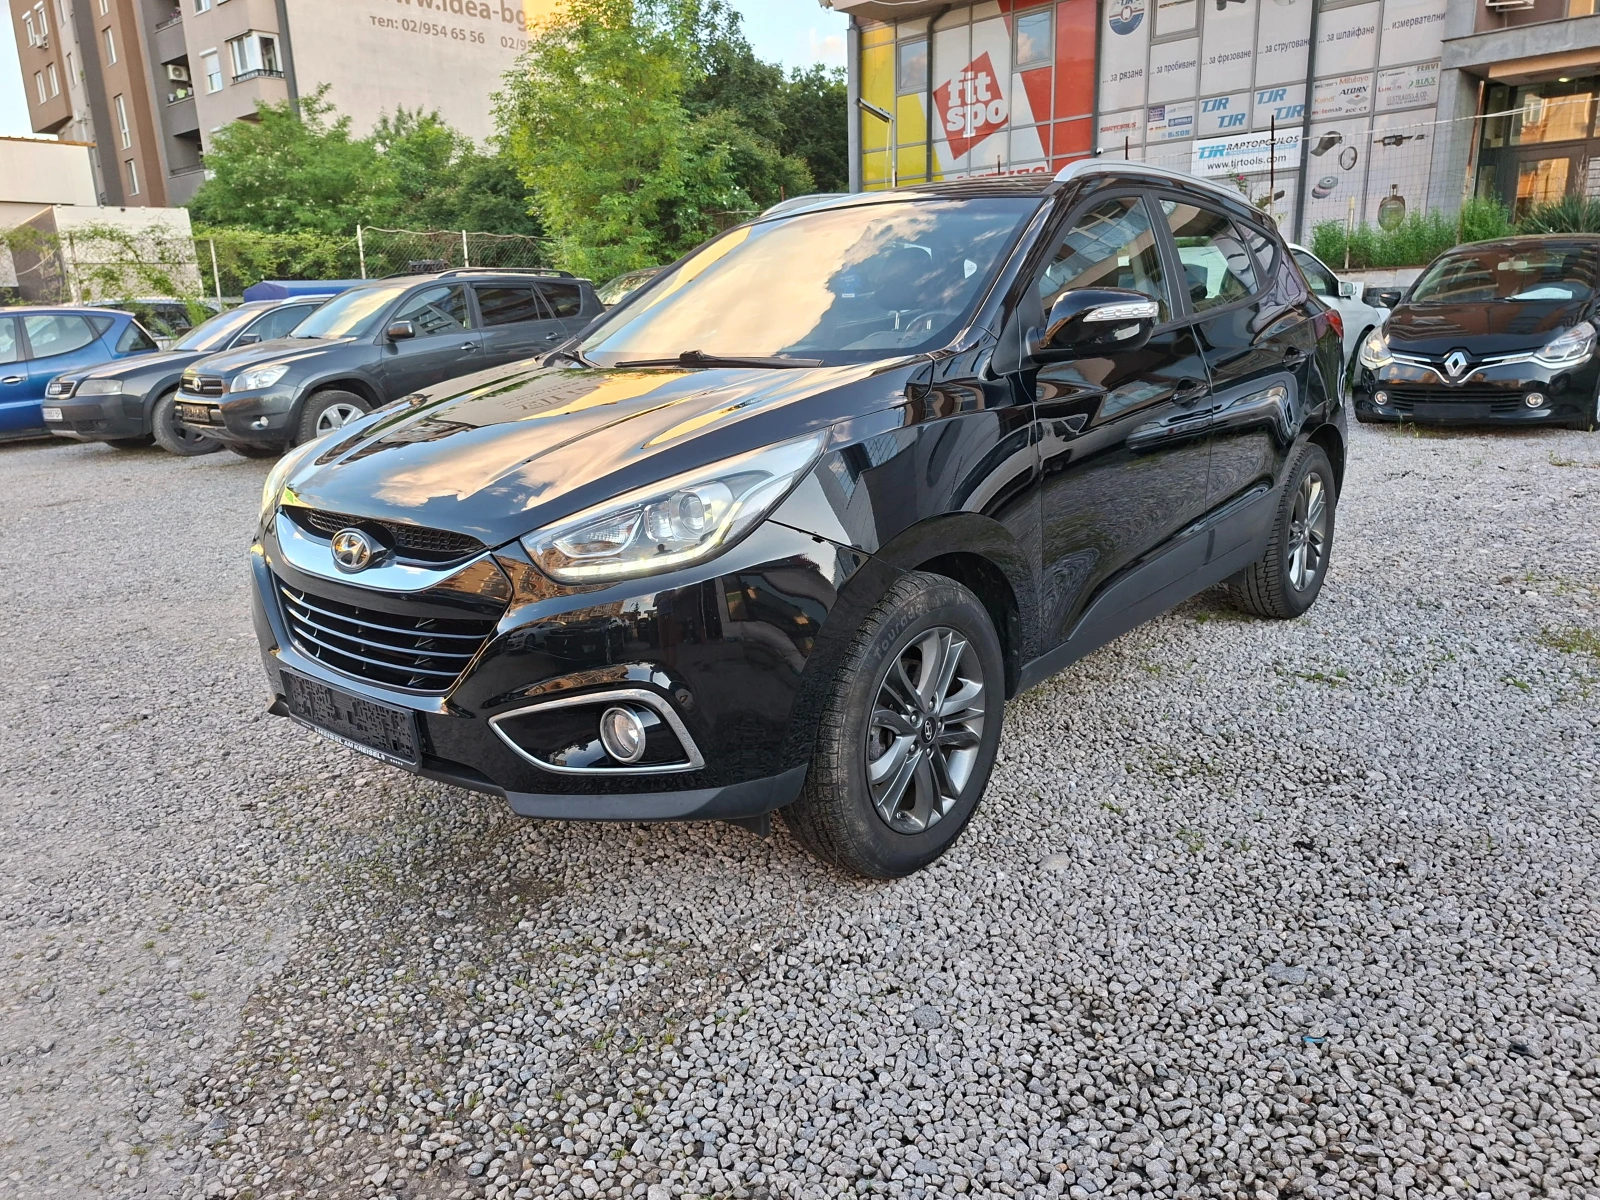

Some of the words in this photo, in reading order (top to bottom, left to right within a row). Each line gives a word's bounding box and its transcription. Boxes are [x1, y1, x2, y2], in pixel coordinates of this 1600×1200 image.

[385, 0, 527, 32] w.idea-bg
[1391, 12, 1446, 29] измервателни
[369, 15, 399, 30] тел:
[401, 18, 448, 38] 02/954
[450, 27, 467, 42] 65
[469, 31, 486, 45] 56
[1326, 33, 1335, 42] за
[1335, 25, 1375, 40] шлайфане
[1208, 56, 1216, 65] за
[1216, 49, 1252, 65] фрезоване
[1264, 45, 1273, 54] за
[1156, 65, 1163, 74] за
[1163, 59, 1197, 74] пробиване
[1109, 73, 1118, 82] за
[1118, 68, 1143, 83] рязане
[1338, 75, 1369, 86] Mitutoyo
[947, 70, 991, 107] fit
[1256, 88, 1287, 105] TJR
[1201, 97, 1230, 113] TJR
[1273, 104, 1305, 121] TJR
[946, 98, 1009, 138] spo
[1217, 113, 1246, 128] TJR
[1198, 144, 1227, 159] TJR
[1226, 135, 1300, 151] RAPTOPOULOS
[1206, 154, 1287, 170] www.tjrtools.com
